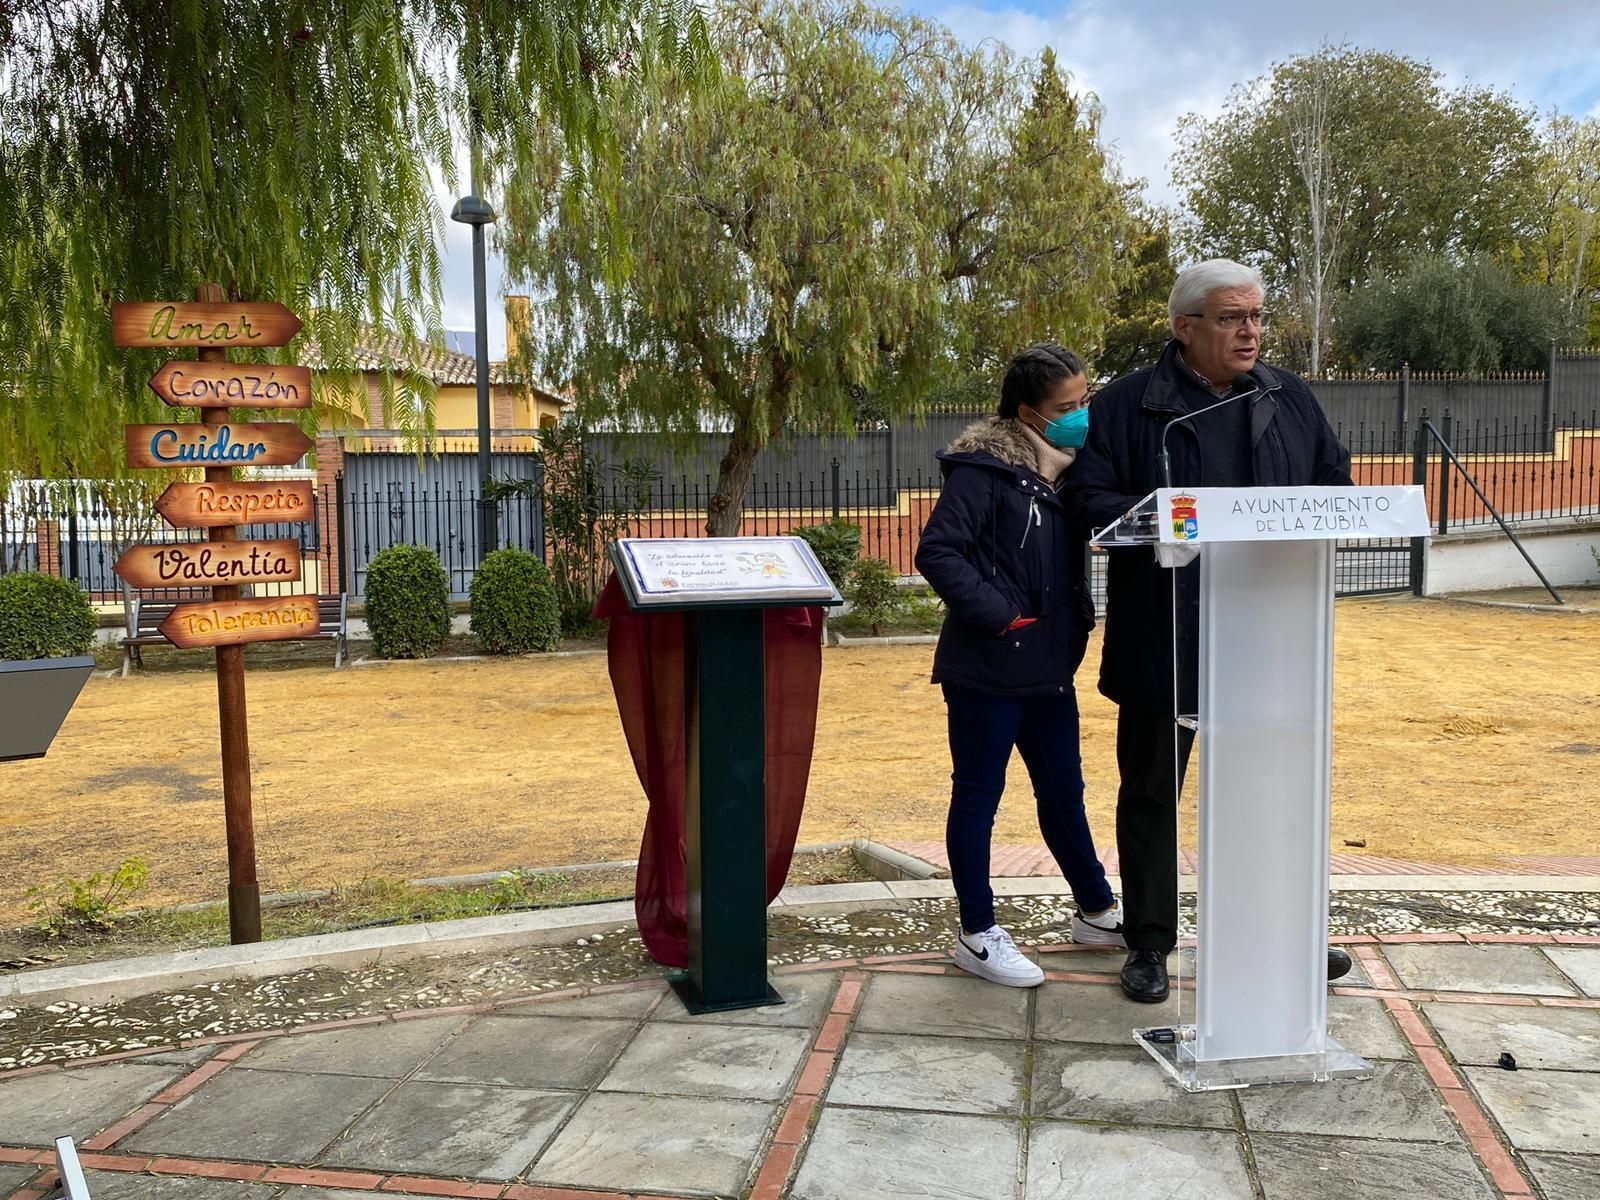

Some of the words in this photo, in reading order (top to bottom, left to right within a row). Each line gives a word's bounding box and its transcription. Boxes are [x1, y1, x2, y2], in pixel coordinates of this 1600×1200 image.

[149, 306, 261, 340] Amar
[168, 371, 299, 400] Corazón
[150, 425, 266, 463] Cuidar
[195, 486, 304, 521] Respeto
[1231, 496, 1390, 514] AYUNTAMIENTO
[1256, 519, 1275, 532] DE
[1282, 517, 1304, 532] LA
[1311, 515, 1369, 531] ZUBIA
[153, 546, 292, 580] Valentía
[182, 606, 314, 635] Tolerancia
